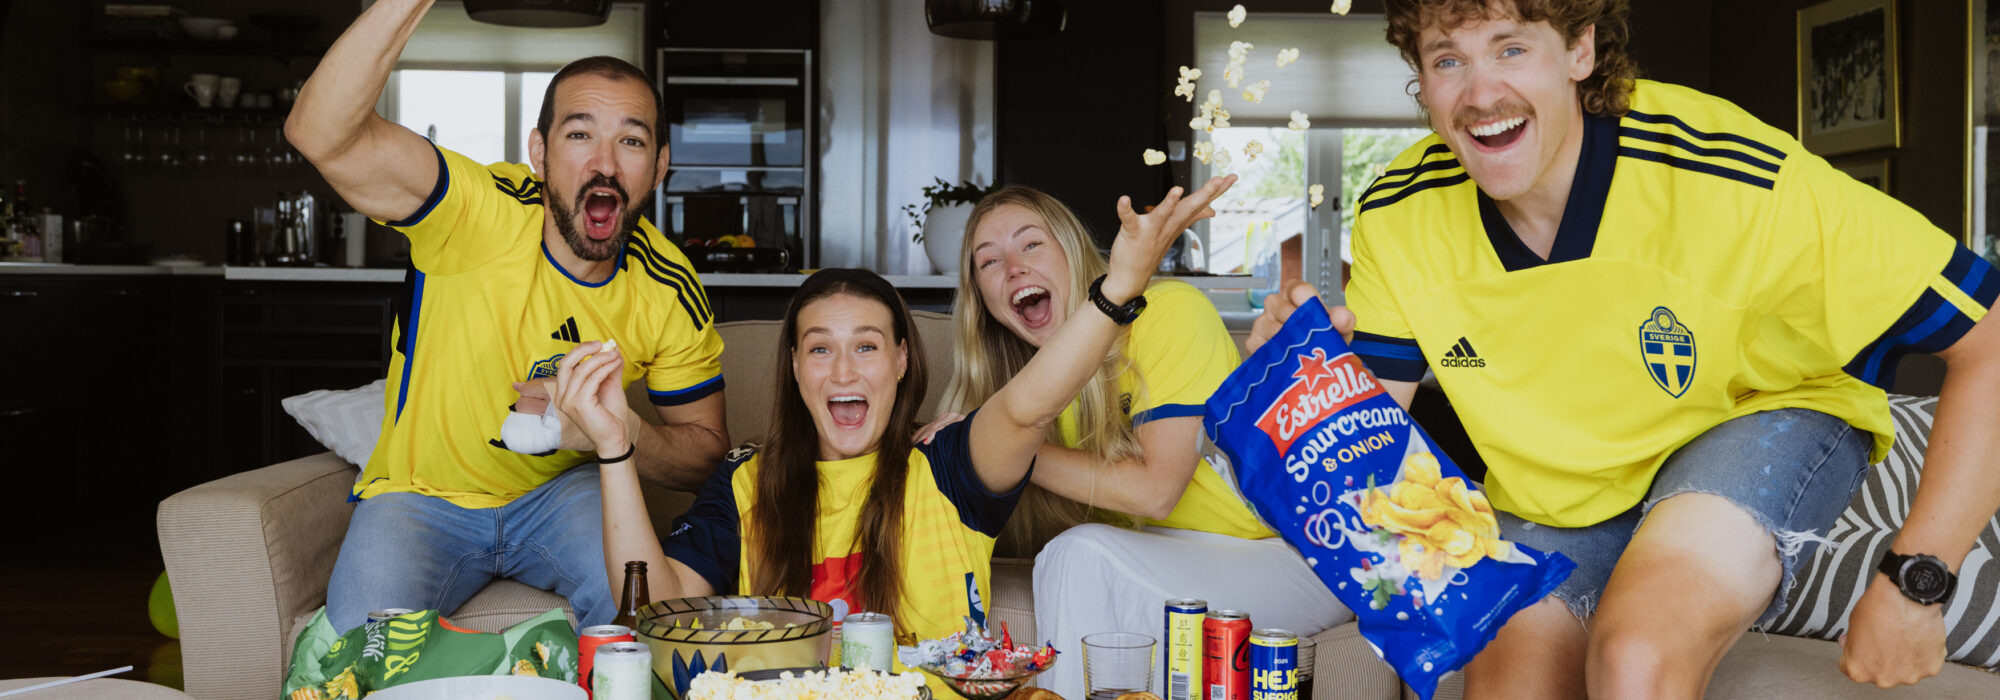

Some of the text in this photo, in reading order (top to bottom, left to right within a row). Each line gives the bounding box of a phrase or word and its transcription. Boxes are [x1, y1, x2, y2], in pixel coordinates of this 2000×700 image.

[1649, 333, 1686, 342] SVERIGE
[1440, 356, 1486, 368] adidas
[1276, 363, 1376, 441] Estrella
[1285, 406, 1408, 482] Sourcream
[1322, 430, 1395, 472] & ONION
[383, 651, 420, 681] &
